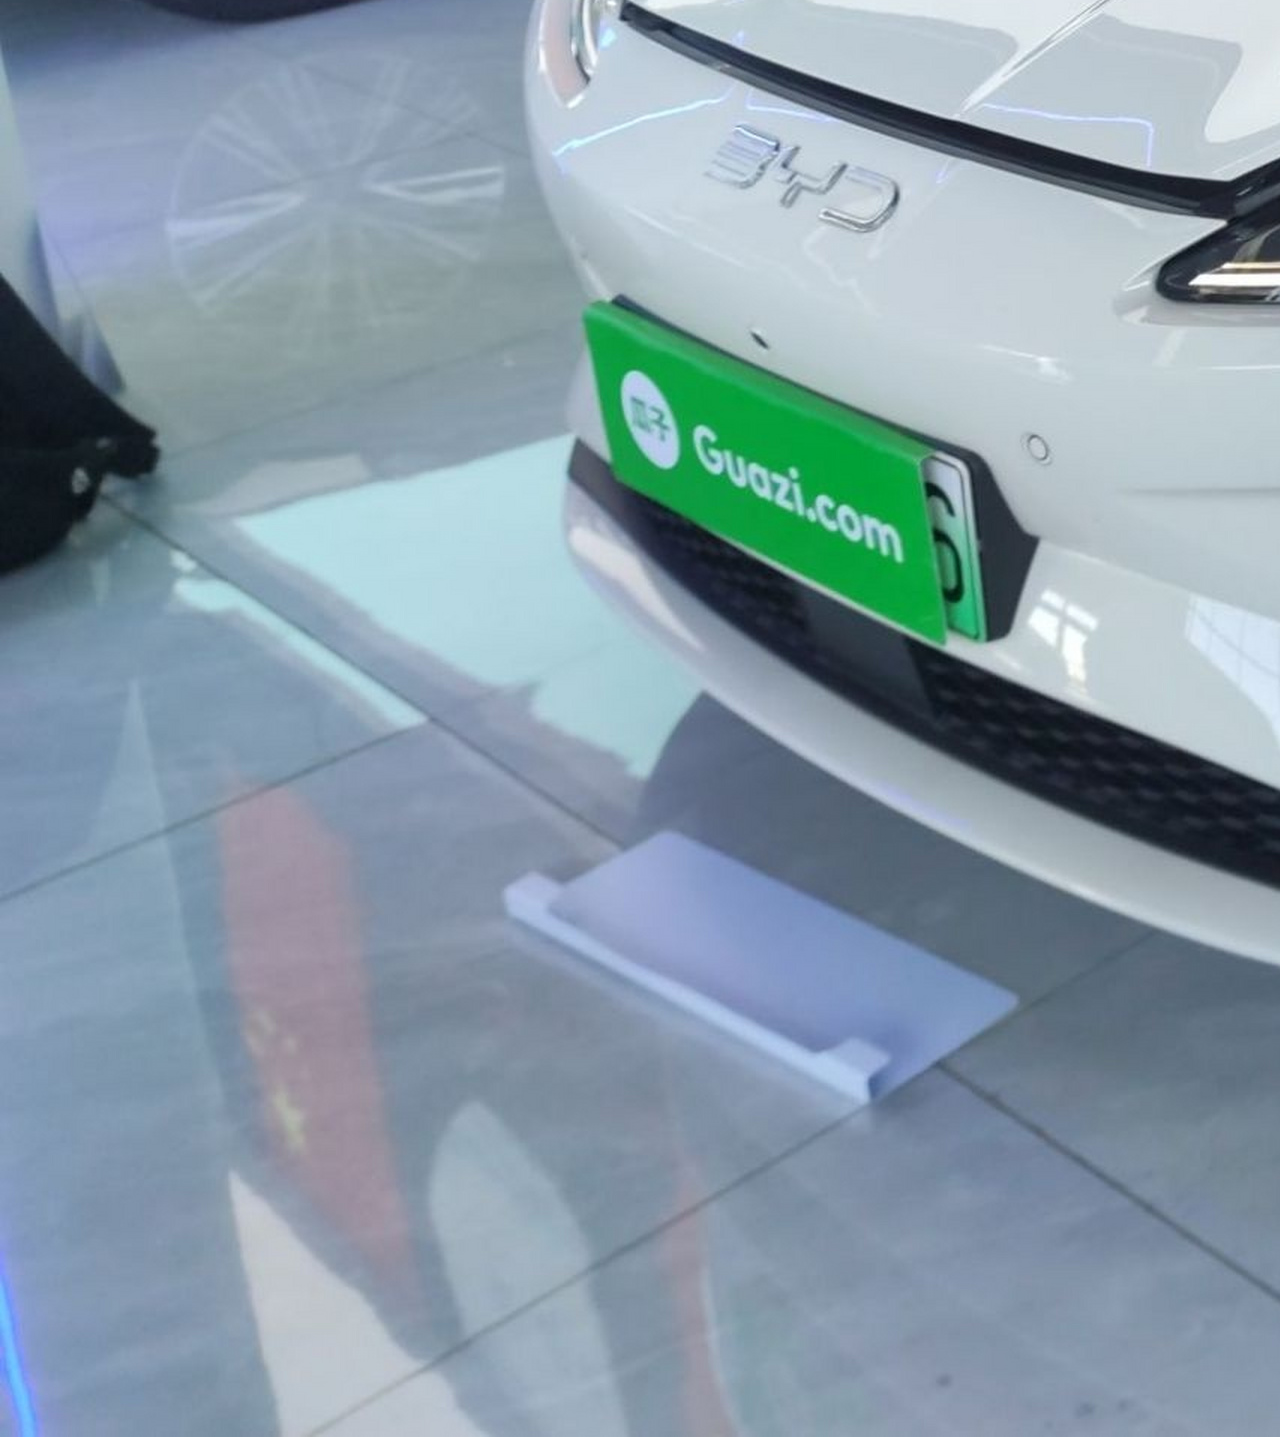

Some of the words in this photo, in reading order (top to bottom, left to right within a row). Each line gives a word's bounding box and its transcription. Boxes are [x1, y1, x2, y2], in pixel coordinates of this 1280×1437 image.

[703, 123, 901, 233] BYD
[631, 396, 671, 443] 瓜子
[692, 424, 904, 563] Guazi.com
